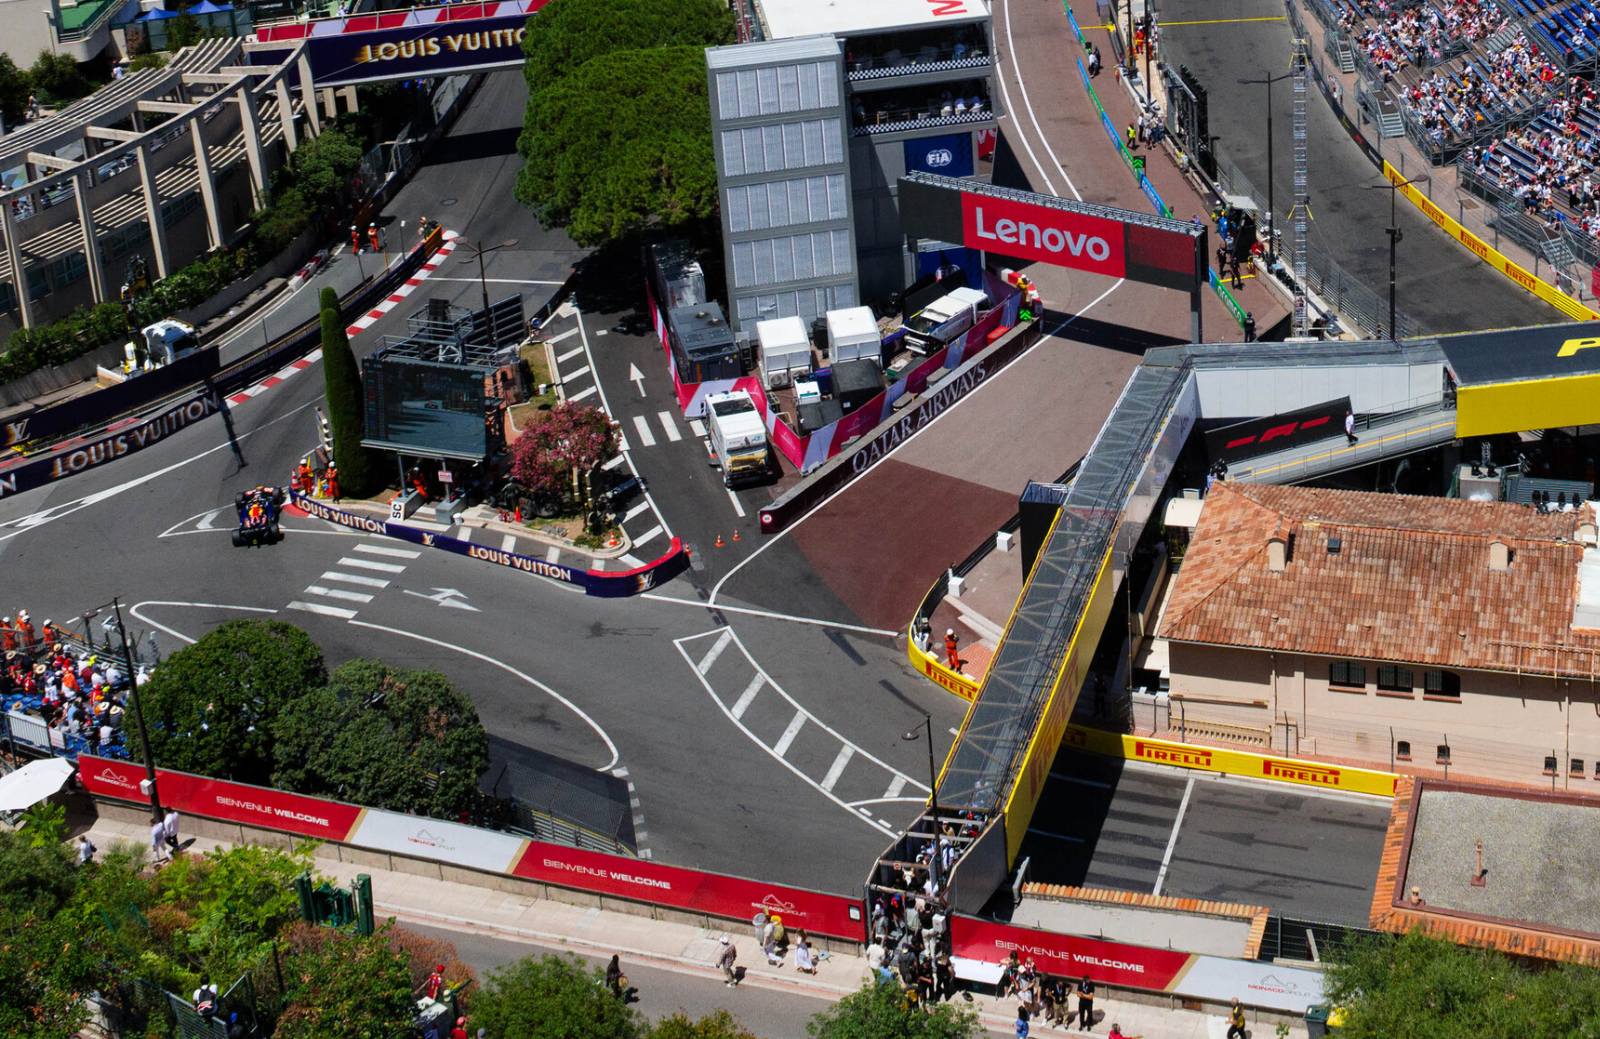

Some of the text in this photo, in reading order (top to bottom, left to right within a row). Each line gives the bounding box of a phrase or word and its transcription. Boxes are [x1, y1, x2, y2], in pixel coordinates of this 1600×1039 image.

[363, 27, 528, 63] LOUIS VUITTO
[976, 207, 1110, 261] Lenovo
[1504, 262, 1536, 291] PIRELLI
[853, 361, 987, 473] QATAR AIRWAYS
[54, 395, 221, 478] LOUIS VUITTON
[296, 497, 387, 535] LOUIS VUITTON
[392, 503, 402, 519] SC
[469, 545, 572, 582] LOUIS VUITTON
[925, 660, 978, 700] PIRELL
[1135, 741, 1212, 767] PIRELLI
[1263, 760, 1341, 785] PIRELLI
[216, 795, 330, 827] BIENVENUE WELCOME
[543, 858, 672, 890] BIENVENUE WELCOME
[995, 939, 1145, 974] BIENVENUE WELCOME
